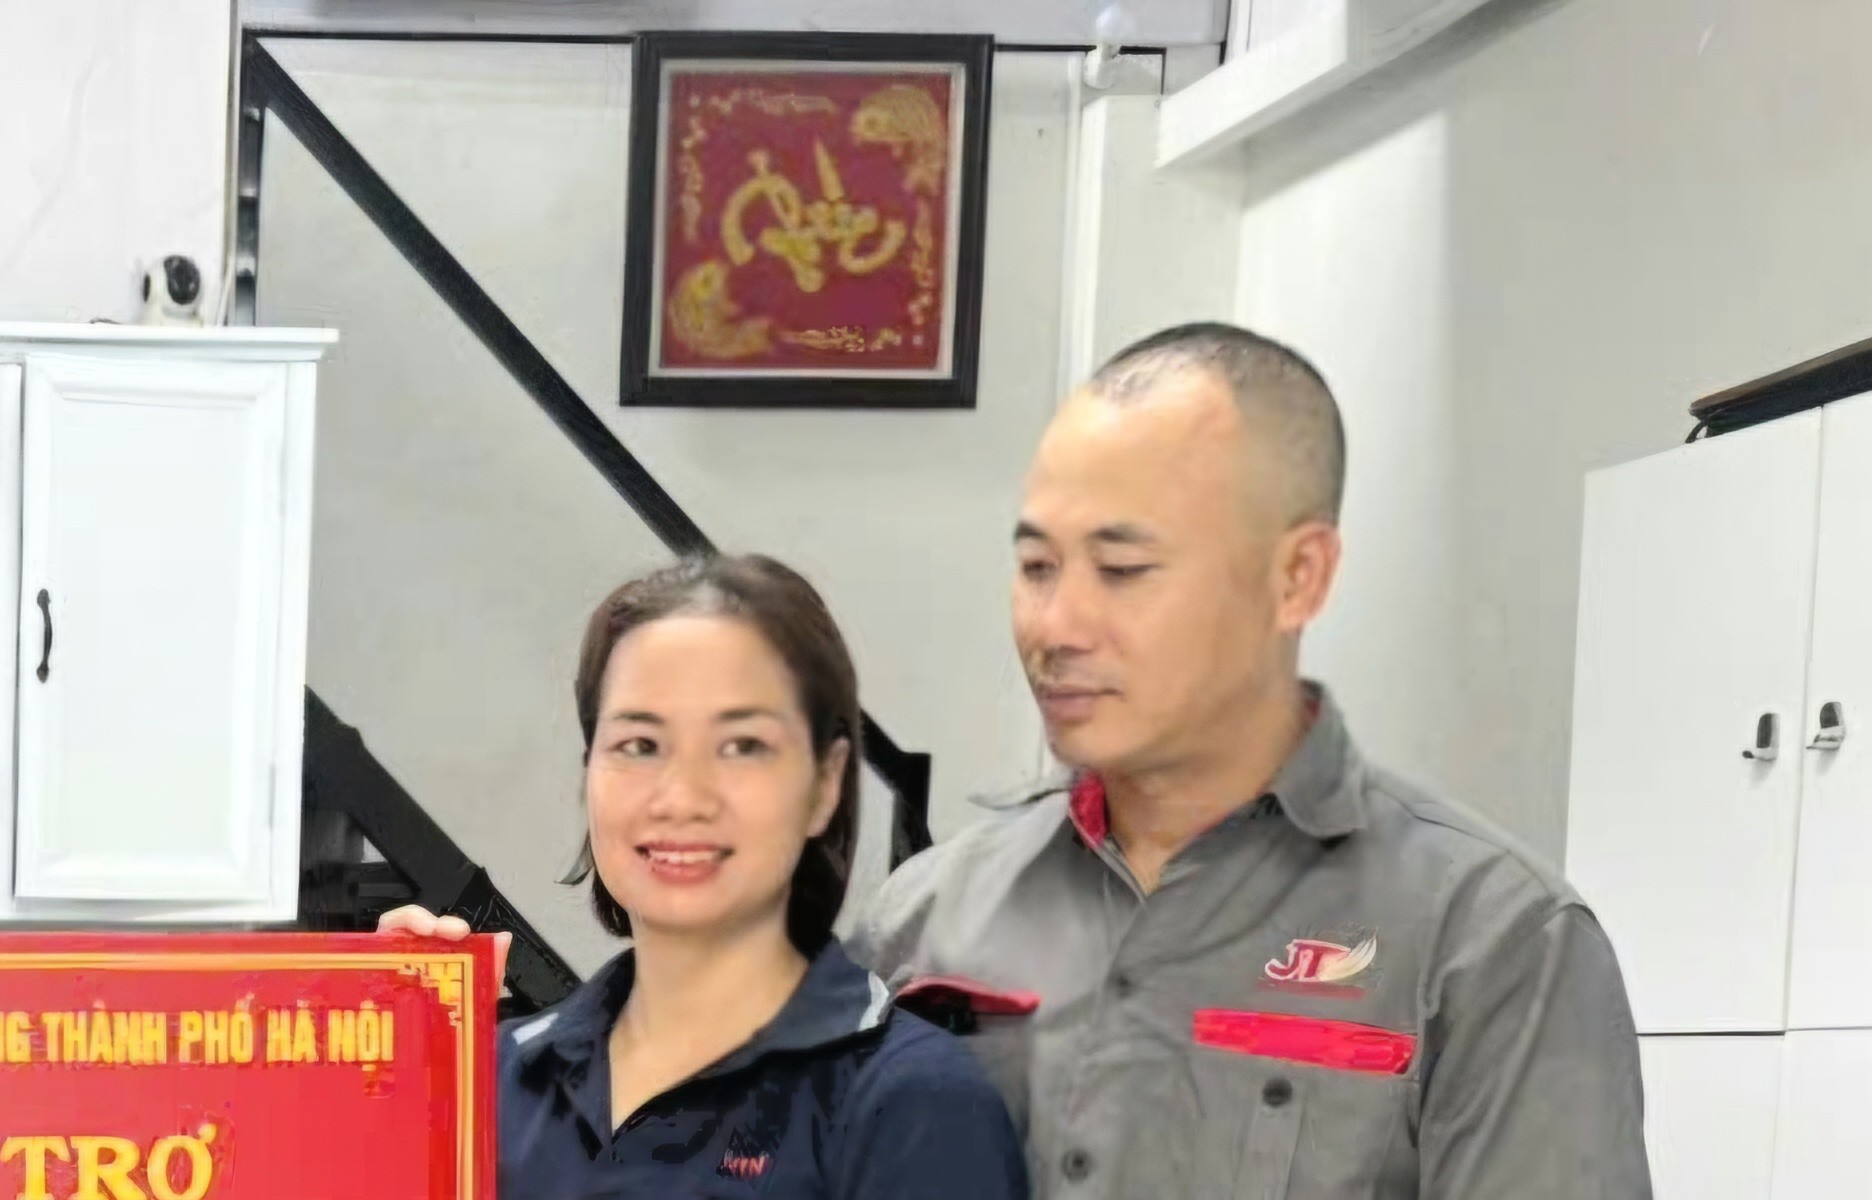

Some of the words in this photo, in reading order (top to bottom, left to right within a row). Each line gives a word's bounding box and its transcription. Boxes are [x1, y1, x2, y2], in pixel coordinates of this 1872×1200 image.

[41, 1000, 167, 1065] THÀNH
[179, 992, 253, 1065] PHỐ
[267, 999, 319, 1064] HÀ
[328, 998, 394, 1072] NỘI
